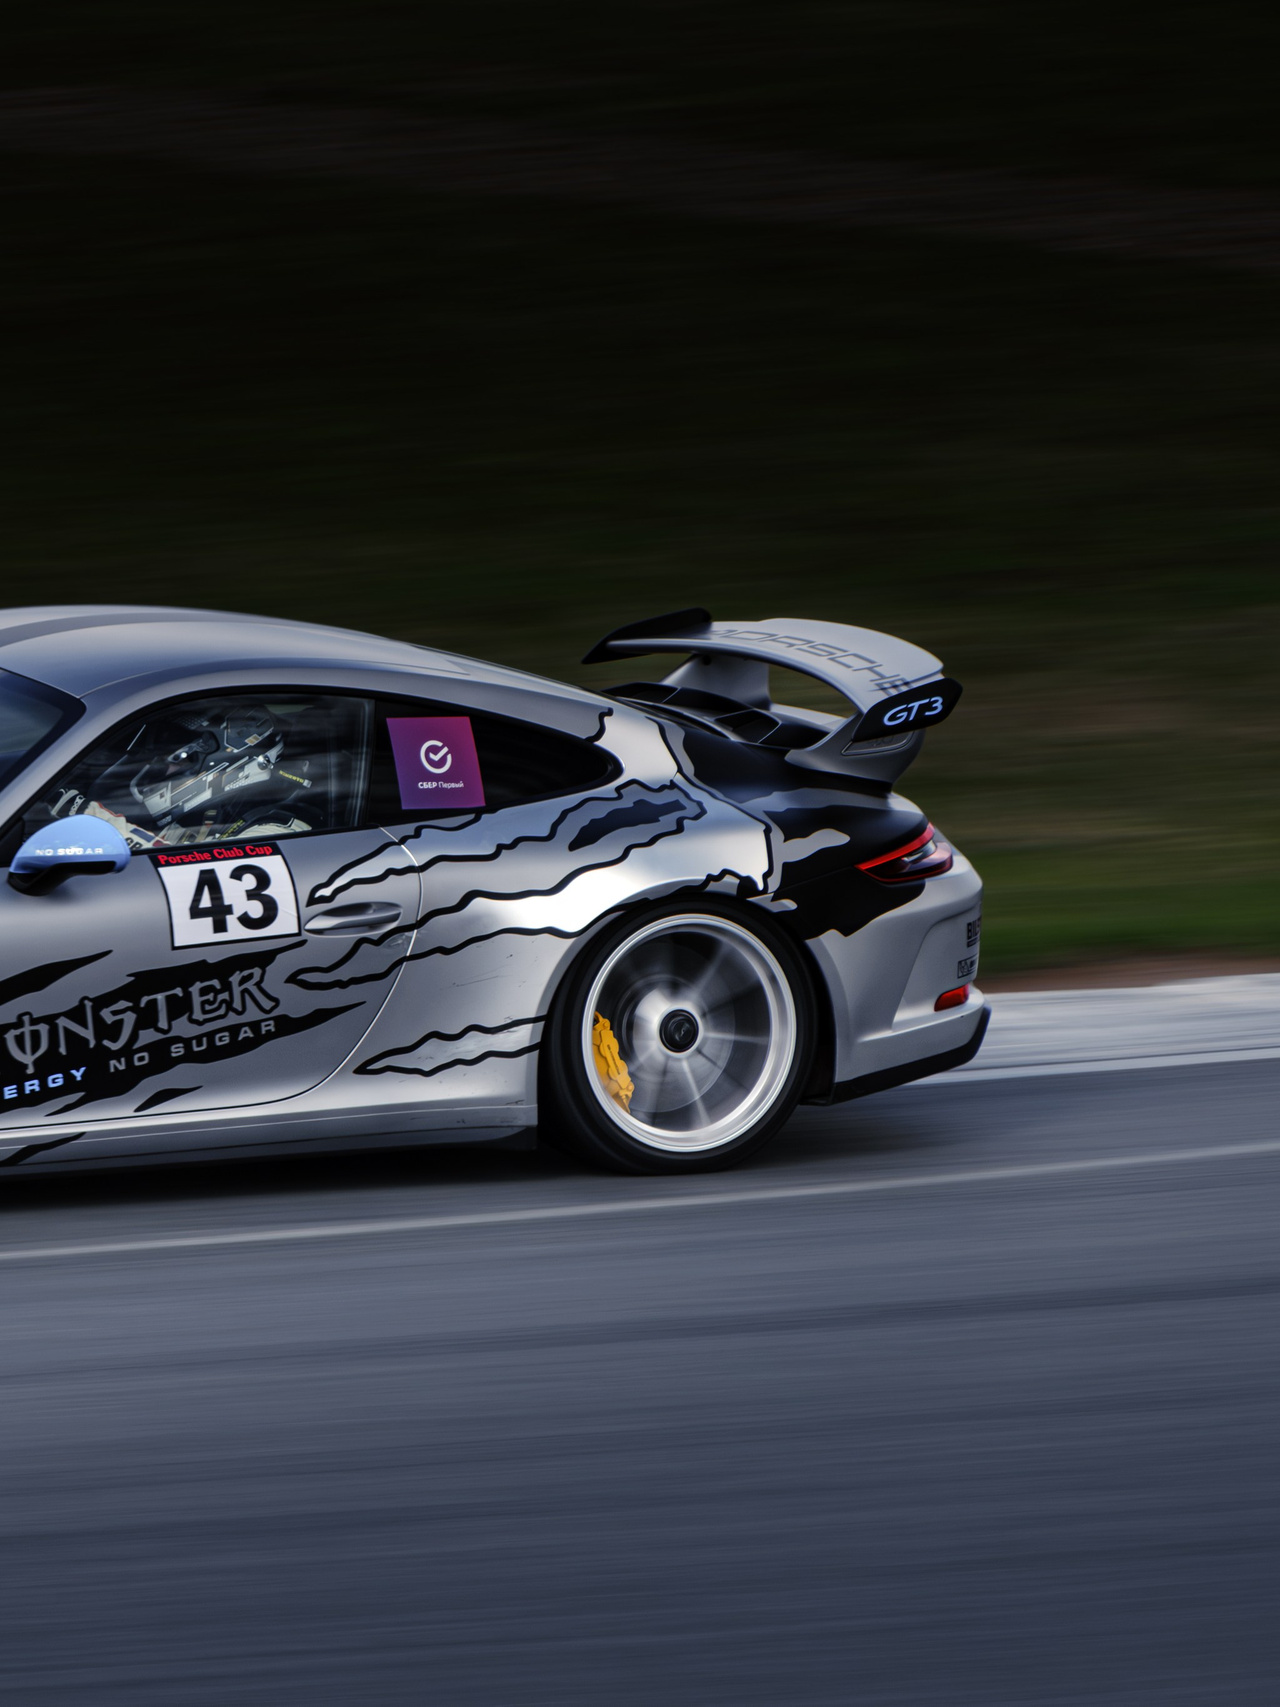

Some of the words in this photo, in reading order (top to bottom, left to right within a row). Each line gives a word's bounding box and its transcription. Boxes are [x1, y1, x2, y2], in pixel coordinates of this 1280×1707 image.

[882, 696, 943, 726] GT3
[418, 781, 437, 789] СБЕР
[35, 848, 54, 856] NO
[157, 852, 211, 865] Porsche
[213, 846, 243, 859] Club
[245, 844, 273, 856] Cup
[189, 864, 279, 934] 43
[109, 1052, 150, 1073] NO
[171, 1020, 277, 1057] SUGAR
